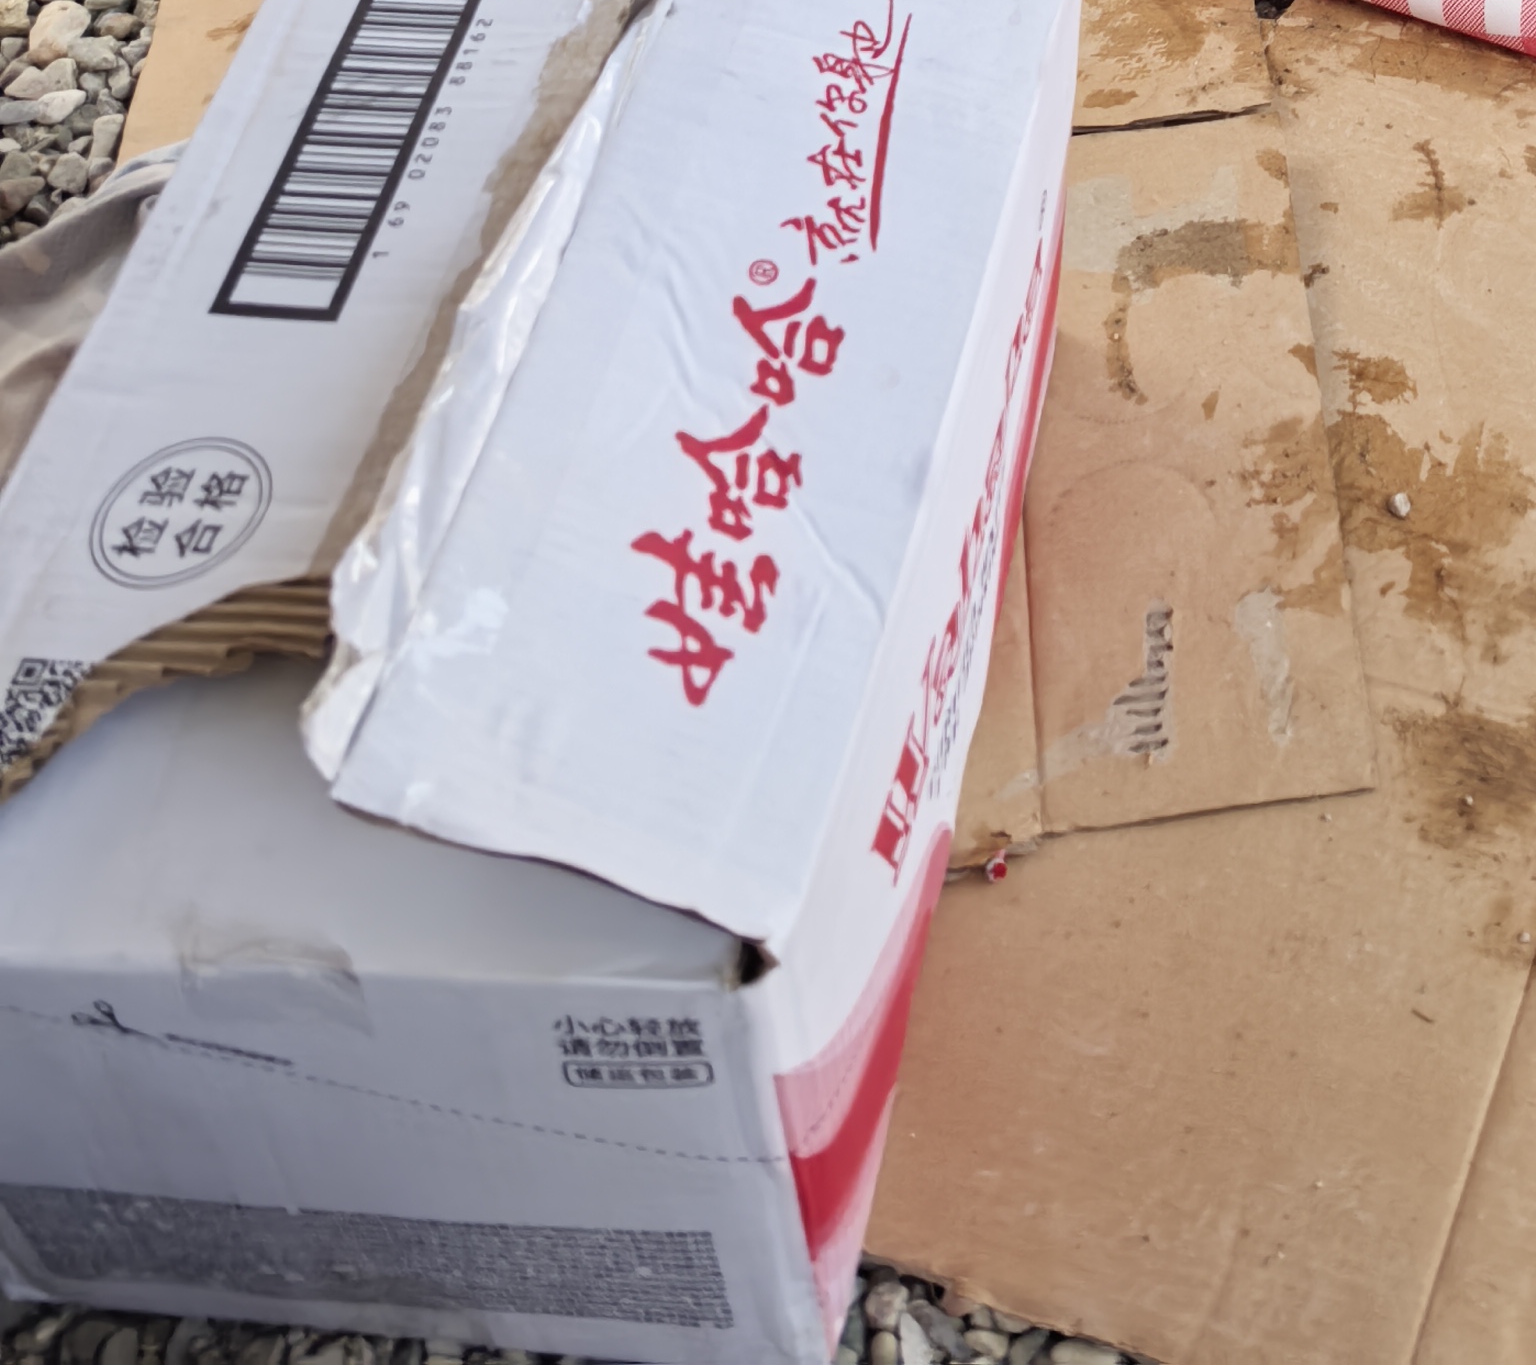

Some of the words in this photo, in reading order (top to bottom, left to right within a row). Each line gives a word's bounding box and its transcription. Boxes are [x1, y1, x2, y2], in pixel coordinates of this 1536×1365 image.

[111, 465, 197, 559] 检验
[173, 470, 252, 559] 合格
[630, 277, 845, 707] 娃哈哈
